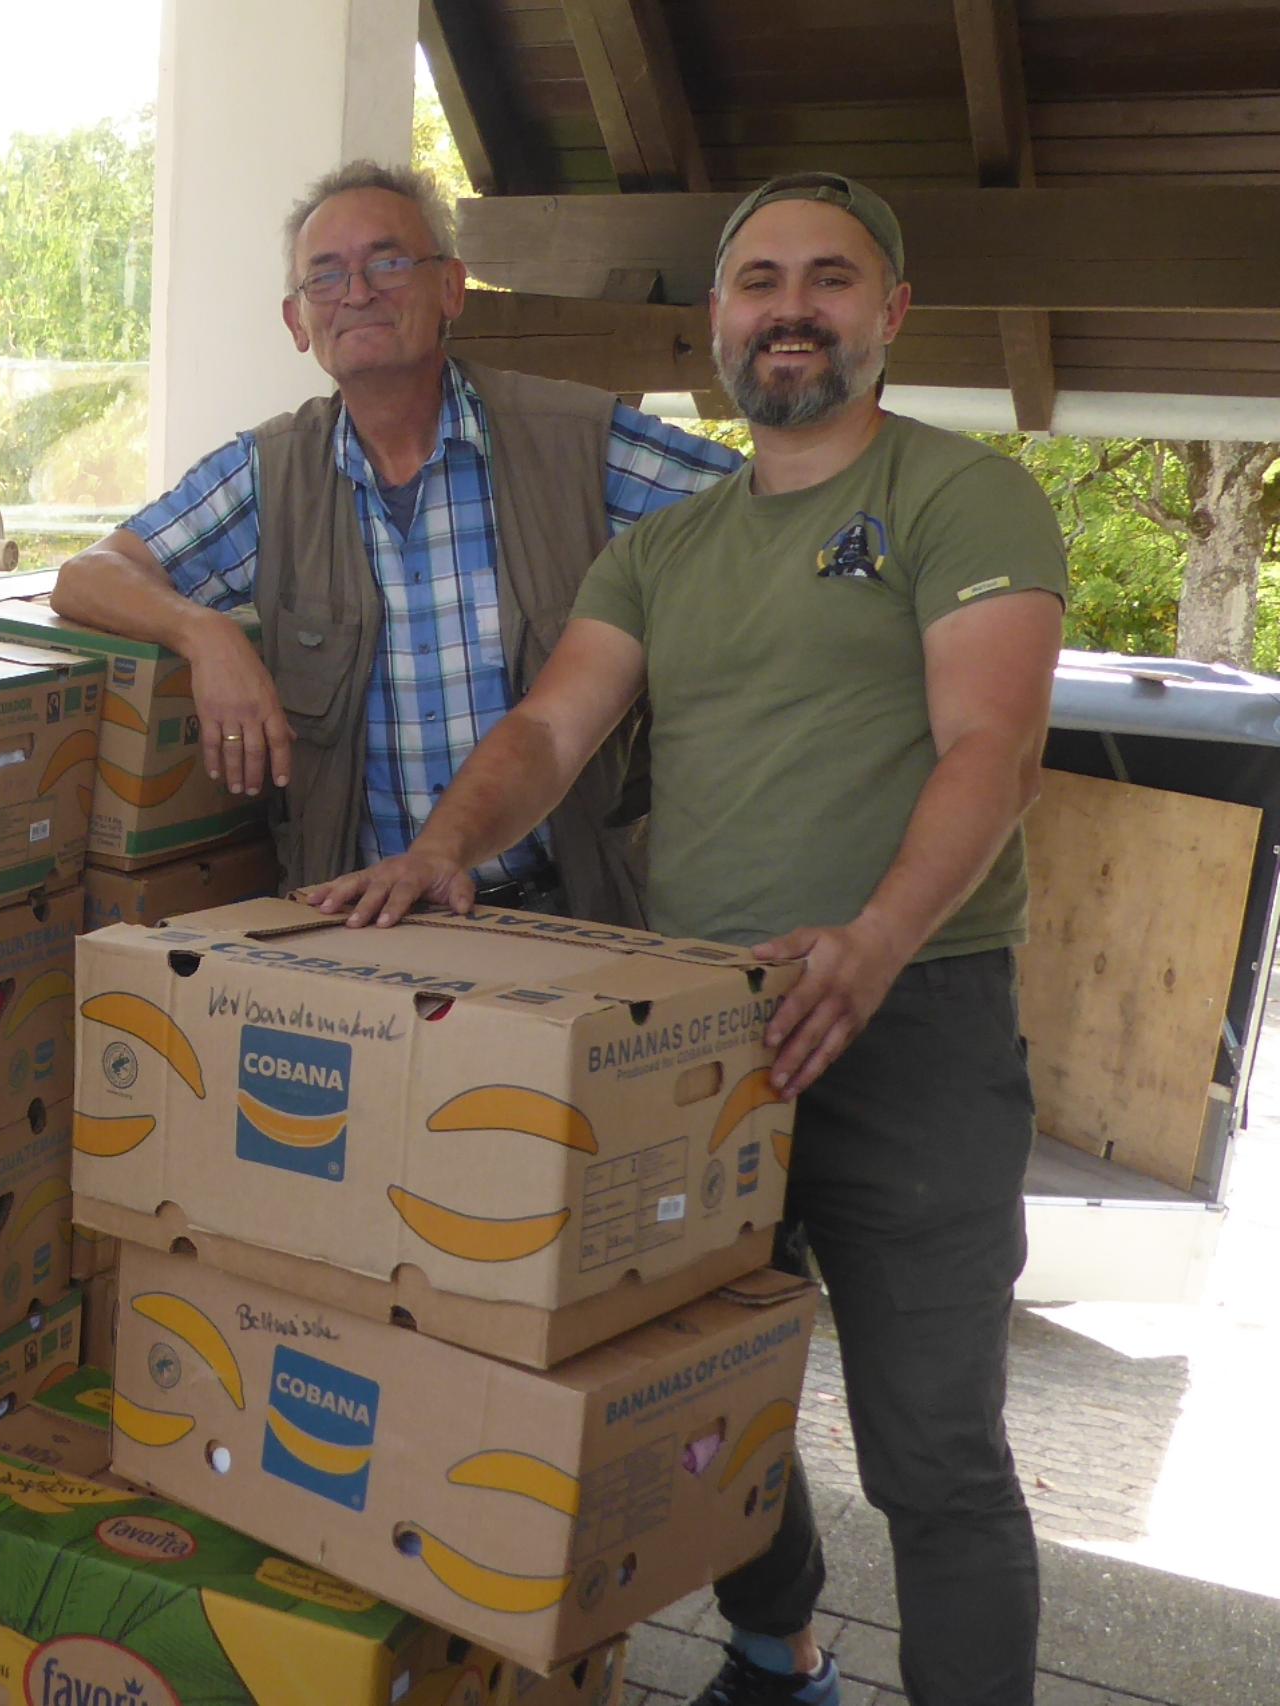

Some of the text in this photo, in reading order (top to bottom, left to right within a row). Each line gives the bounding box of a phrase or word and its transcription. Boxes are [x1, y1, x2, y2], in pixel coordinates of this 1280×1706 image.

[210, 942, 477, 992] COBANA
[589, 1023, 684, 1073] BANANAS
[688, 1014, 713, 1044] OF
[244, 1052, 345, 1092] COBANA
[606, 1366, 692, 1425] BANANAS
[694, 1354, 719, 1383] OF
[720, 1316, 801, 1371] COLOMBIA
[275, 1371, 370, 1427] COBANA
[107, 1518, 189, 1555] favorita
